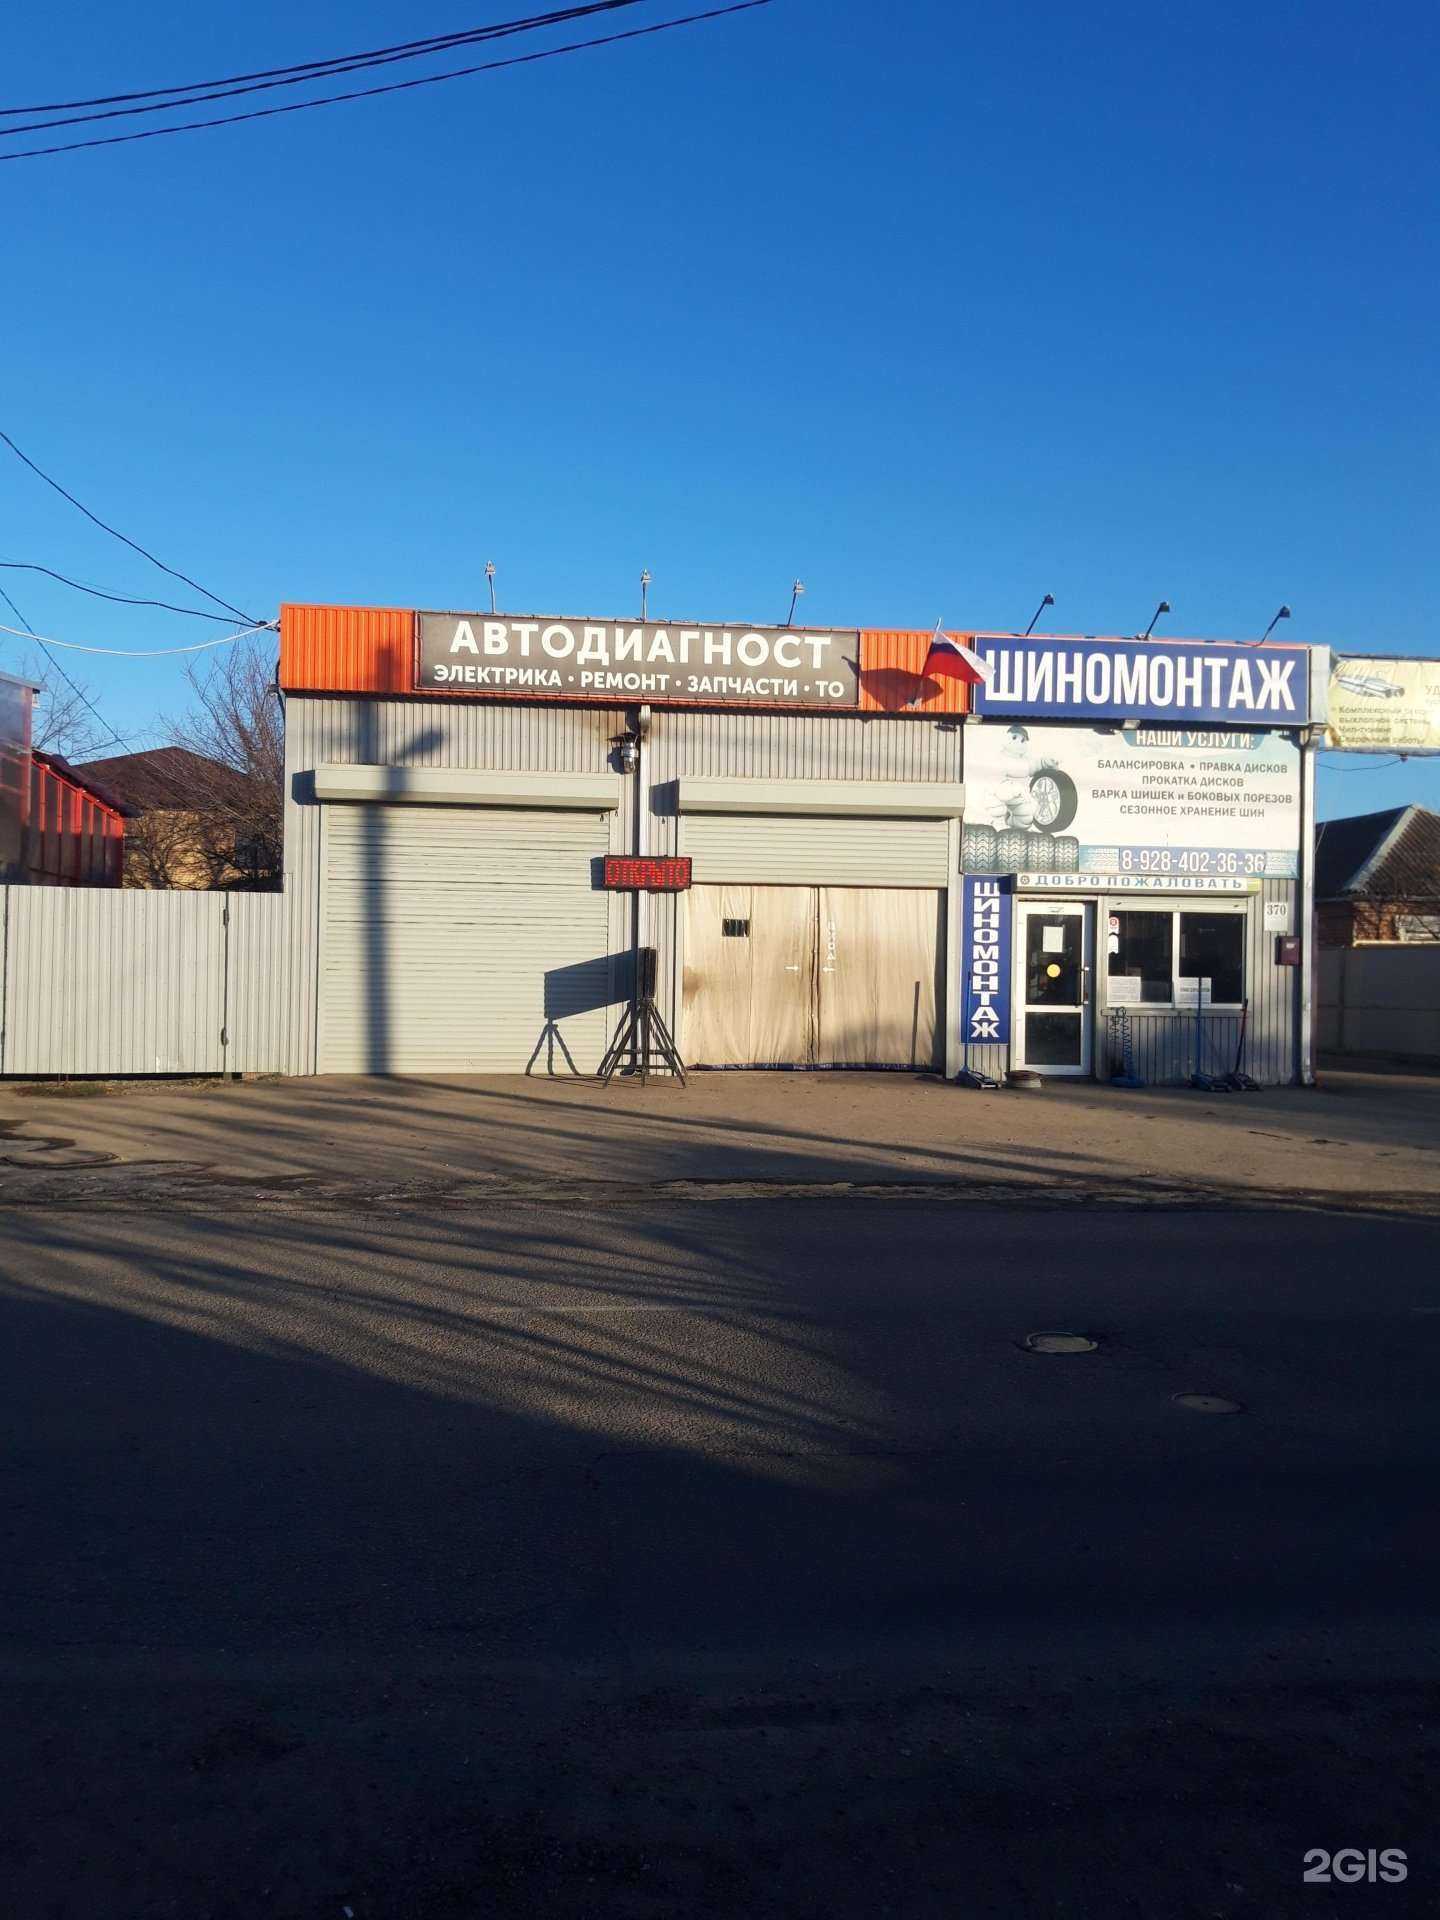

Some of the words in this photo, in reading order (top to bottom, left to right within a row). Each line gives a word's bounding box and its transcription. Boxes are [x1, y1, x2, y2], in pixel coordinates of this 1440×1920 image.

[449, 620, 832, 669] АВТОДИАГНОСТ
[433, 663, 562, 687] ЭЛЕКТРИКА
[580, 671, 671, 691] РЕМОНТ
[687, 675, 798, 697] ЗАПЧАСТИ
[815, 681, 845, 698] ТО
[985, 649, 1296, 711] ШИНОМОНТАЖ
[1136, 730, 1182, 747] НАШИ
[1186, 732, 1255, 749] УСЛУГИ:
[1097, 759, 1184, 770] БАЛАНСИРОВКА
[1199, 762, 1241, 772] ПРАВКА
[1244, 764, 1288, 774] ДИСКОВ
[1142, 776, 1197, 785] ПРОКАТКА
[1200, 777, 1244, 787] ДИСКОВ
[1092, 789, 1127, 799] ВАРКА
[1131, 791, 1174, 800] ШИШЕК
[1187, 792, 1240, 802] БОКОВЫХ
[1243, 793, 1293, 804] ПОРЕЗОВ
[1120, 805, 1177, 815] СЕЗОННОЕ
[1180, 806, 1236, 817] ХРАНЕНИЕ
[1239, 808, 1265, 818] ШИН
[1122, 850, 1265, 873] 8-928-402-36-36
[1035, 875, 1100, 887] ДОБРО
[1107, 876, 1243, 889] ПОЖАЛОВАТЬ
[1266, 904, 1287, 916] 370
[971, 882, 1000, 1038] ШИНОМОНТАЖ
